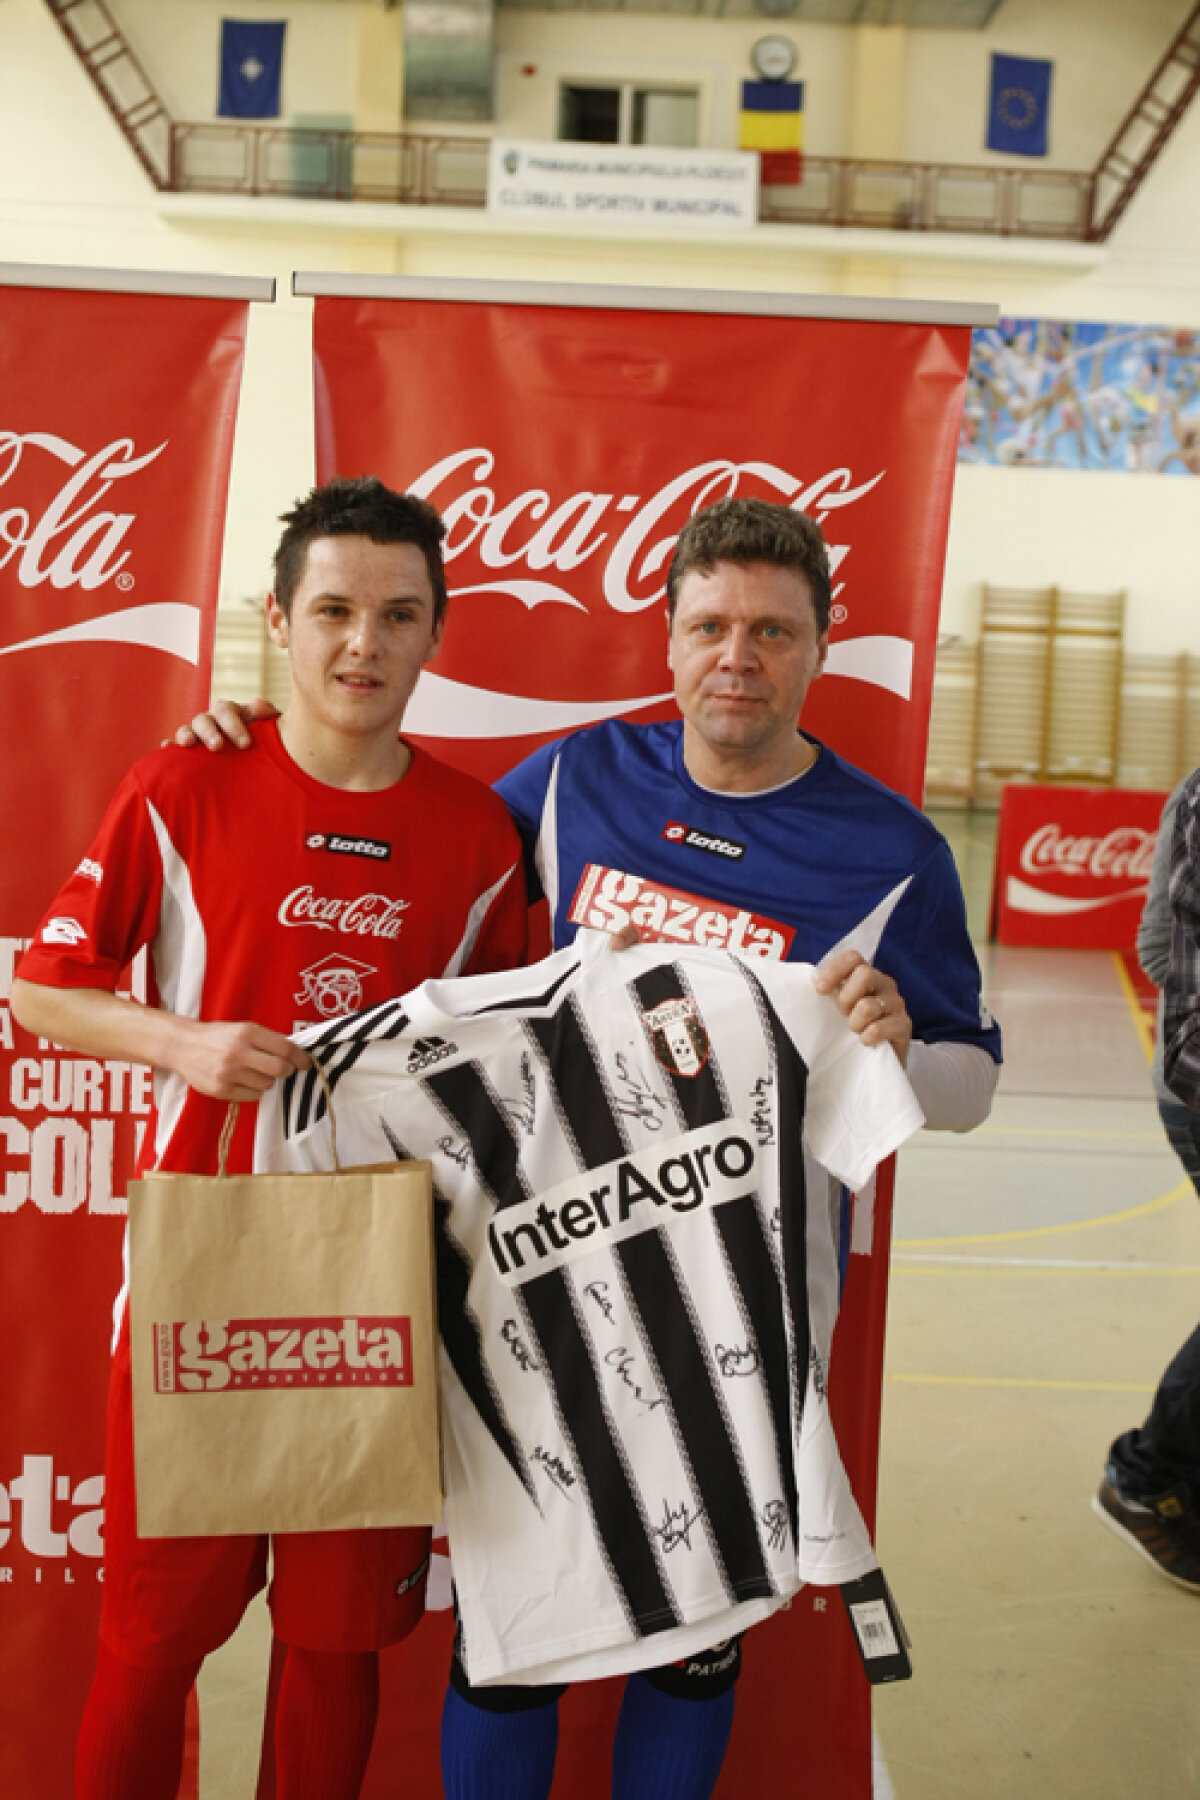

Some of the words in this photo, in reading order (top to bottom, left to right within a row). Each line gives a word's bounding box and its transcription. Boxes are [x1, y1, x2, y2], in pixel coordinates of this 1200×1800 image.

[278, 885, 411, 939] Coca-Cola
[589, 867, 786, 962] gazeta
[11, 1058, 152, 1114] CURTE
[489, 1136, 755, 1275] InterAgro
[178, 1319, 404, 1391] gazeta
